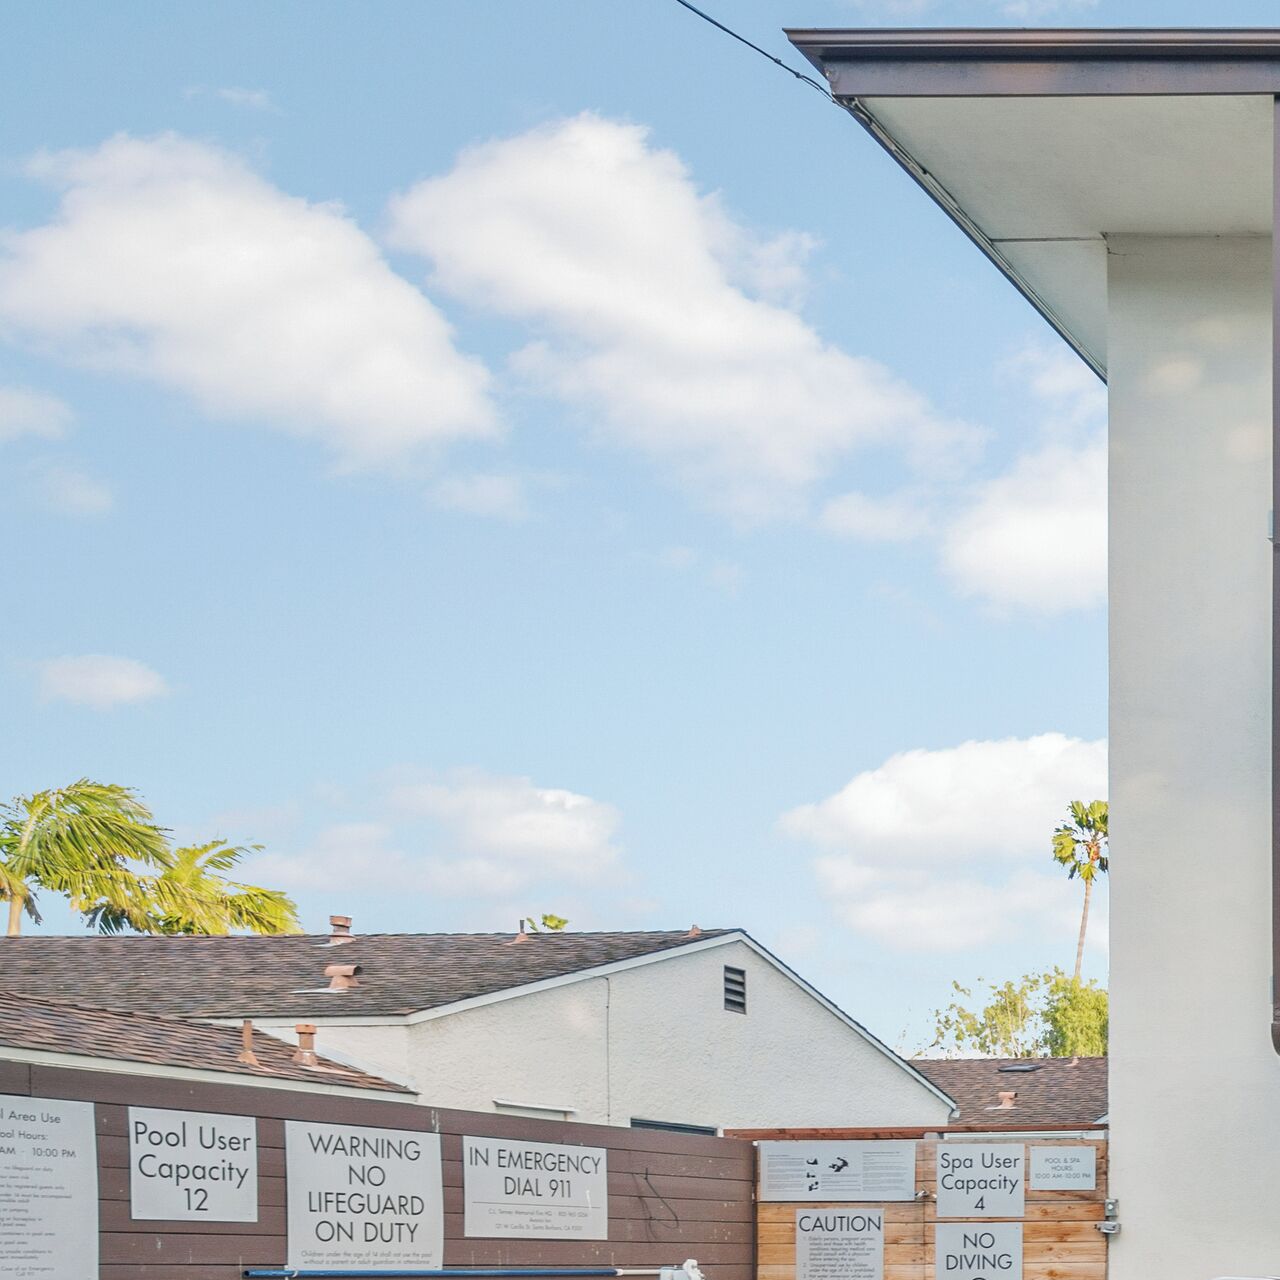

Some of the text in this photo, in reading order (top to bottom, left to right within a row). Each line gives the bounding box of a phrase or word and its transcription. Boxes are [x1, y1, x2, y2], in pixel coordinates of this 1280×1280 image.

[8, 1111, 36, 1122] Area
[41, 1113, 61, 1123] Use
[0, 1130, 14, 1138] ool
[135, 1121, 251, 1151] Pool User
[62, 1150, 76, 1158] PM
[308, 1132, 420, 1161] WARNING
[470, 1146, 601, 1175] IN EMERGENCY
[941, 1152, 1020, 1173] Spa User
[138, 1154, 249, 1189] Capacity
[348, 1164, 386, 1186] NO
[504, 1176, 572, 1198] DIAL 911
[942, 1174, 1018, 1194] Capacity
[184, 1188, 208, 1211] 12
[308, 1191, 424, 1216] LIFEGUARD
[974, 1195, 986, 1210] 4
[315, 1220, 419, 1243] ON DUTY
[798, 1216, 882, 1232] CAUTION
[964, 1232, 995, 1248] NO
[946, 1254, 1012, 1270] DIVING
